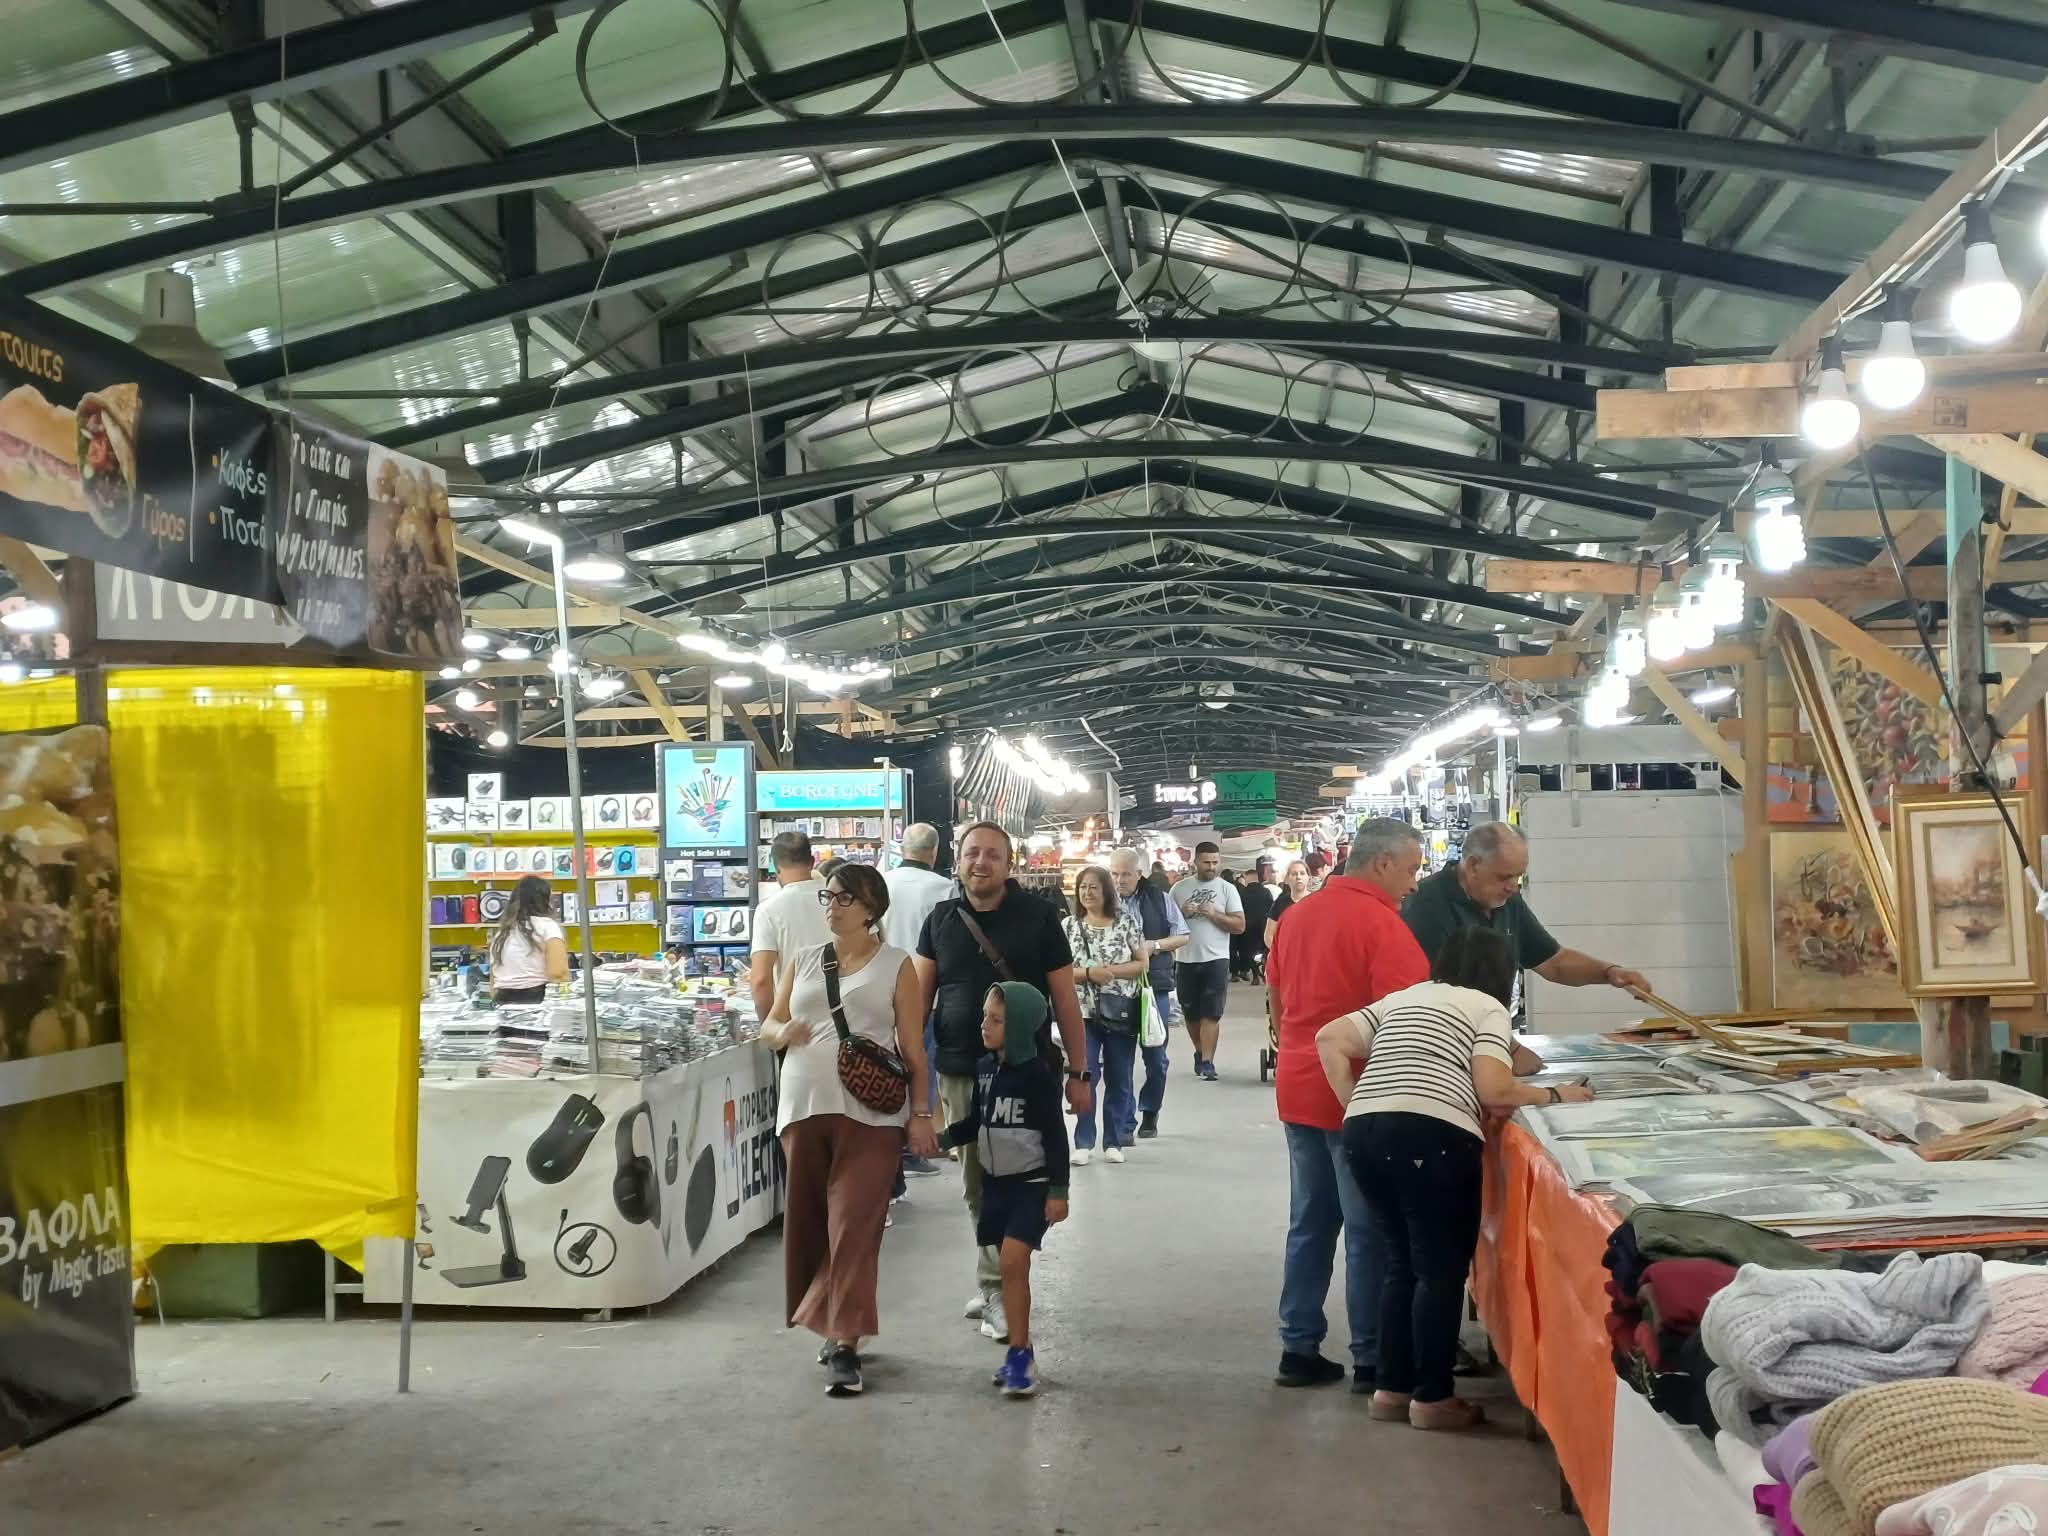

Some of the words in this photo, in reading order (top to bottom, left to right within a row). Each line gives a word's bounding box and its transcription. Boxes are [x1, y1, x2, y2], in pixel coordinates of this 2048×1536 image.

[781, 783, 878, 797] BOROFONE
[680, 849, 696, 857] Hot
[716, 849, 731, 857] List
[22, 1263, 44, 1310] by
[48, 1246, 94, 1298] Magic
